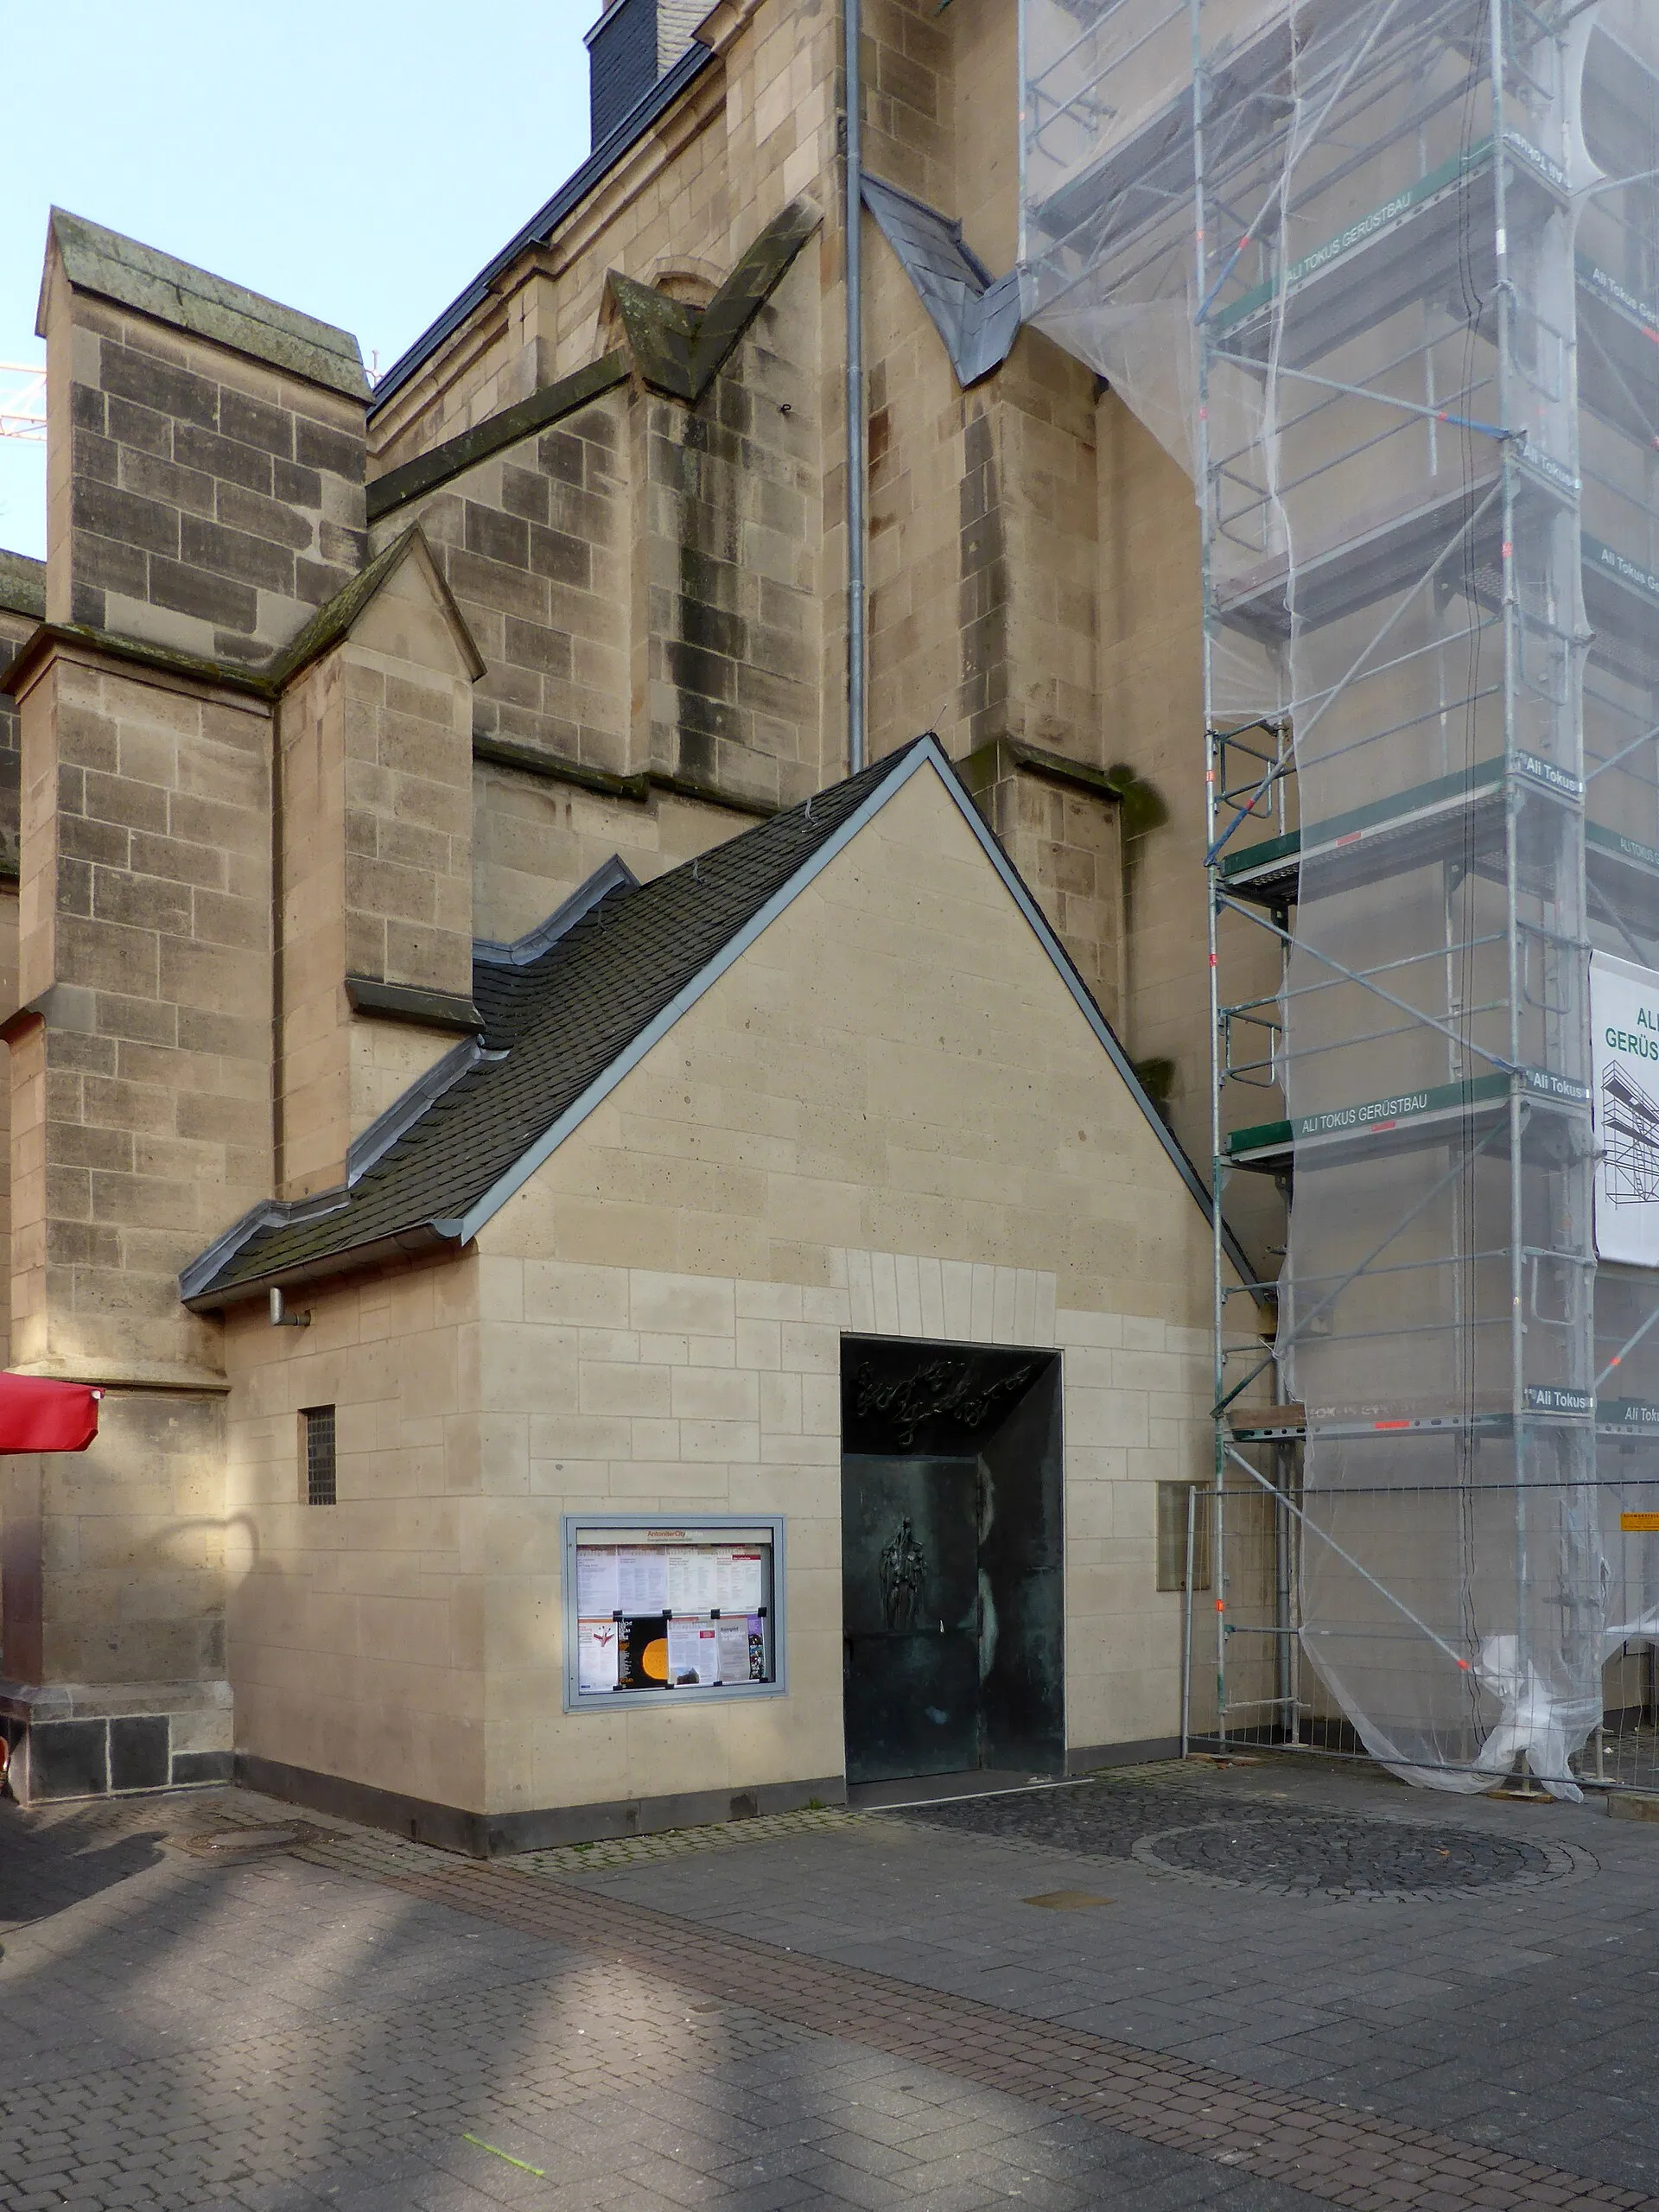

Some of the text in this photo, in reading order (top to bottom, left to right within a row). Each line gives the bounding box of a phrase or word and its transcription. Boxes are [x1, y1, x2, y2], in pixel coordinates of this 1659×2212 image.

[1304, 239, 1340, 272] TOKUS
[1342, 192, 1411, 247] GERÜSTBAU
[1601, 549, 1615, 566] Ali
[1617, 556, 1646, 584] Tokus
[1526, 757, 1575, 791] Ali Tokus
[1605, 1027, 1659, 1061] GERÜS
[1533, 1072, 1583, 1098] Ali Tokus
[1301, 1093, 1427, 1134] ALI TOKUS GERÜSTBAU
[1536, 1389, 1586, 1408] Ali Tokus
[1624, 1407, 1638, 1421] Ali
